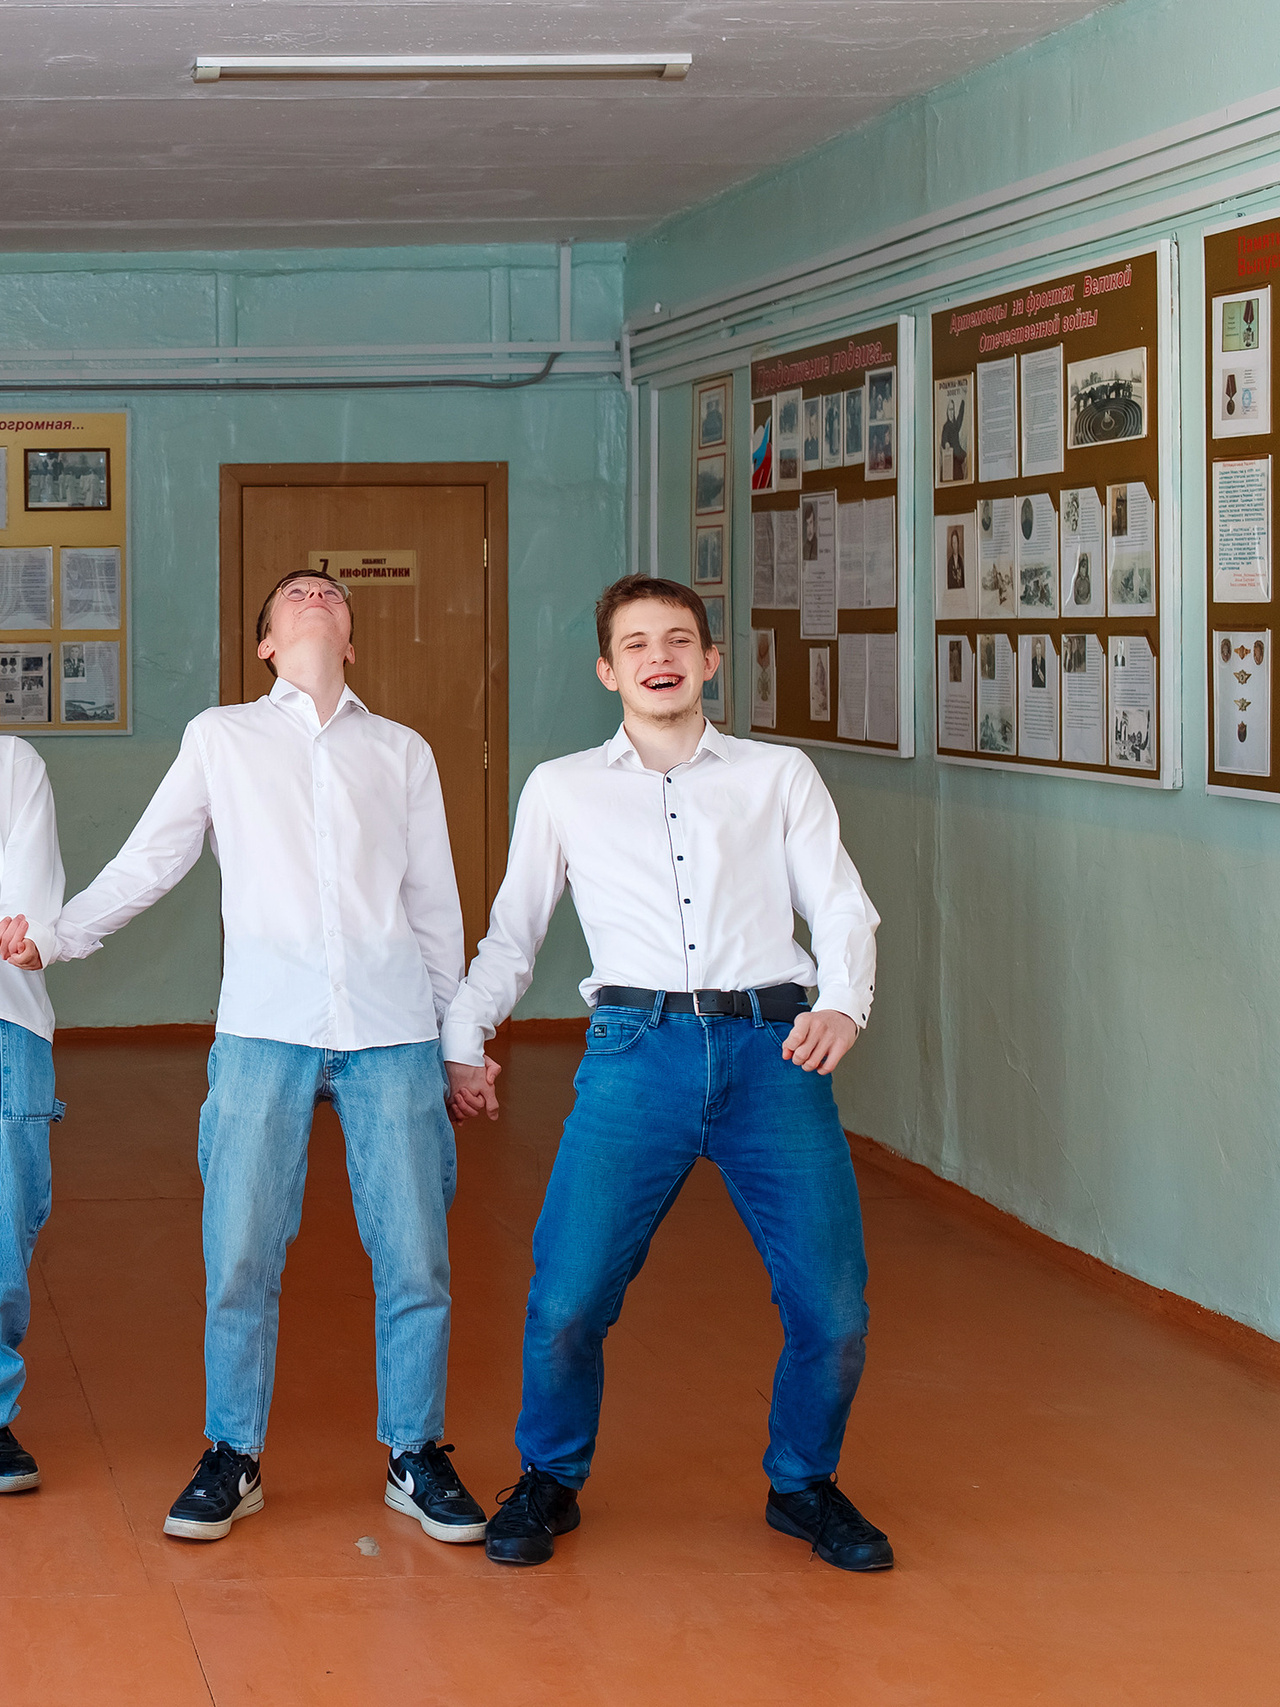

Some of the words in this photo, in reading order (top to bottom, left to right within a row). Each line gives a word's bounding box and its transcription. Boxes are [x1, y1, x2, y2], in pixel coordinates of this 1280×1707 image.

[1238, 254, 1280, 276] Выпус
[949, 302, 1008, 337] Артемовцы
[1011, 298, 1024, 317] на
[1025, 283, 1076, 317] фронтах
[1082, 263, 1133, 298] Великой
[979, 313, 1060, 353] Отечественной
[1062, 307, 1099, 333] войны
[756, 355, 830, 393] Продолжение
[339, 567, 410, 577] ИНФОРМАТИКИ
